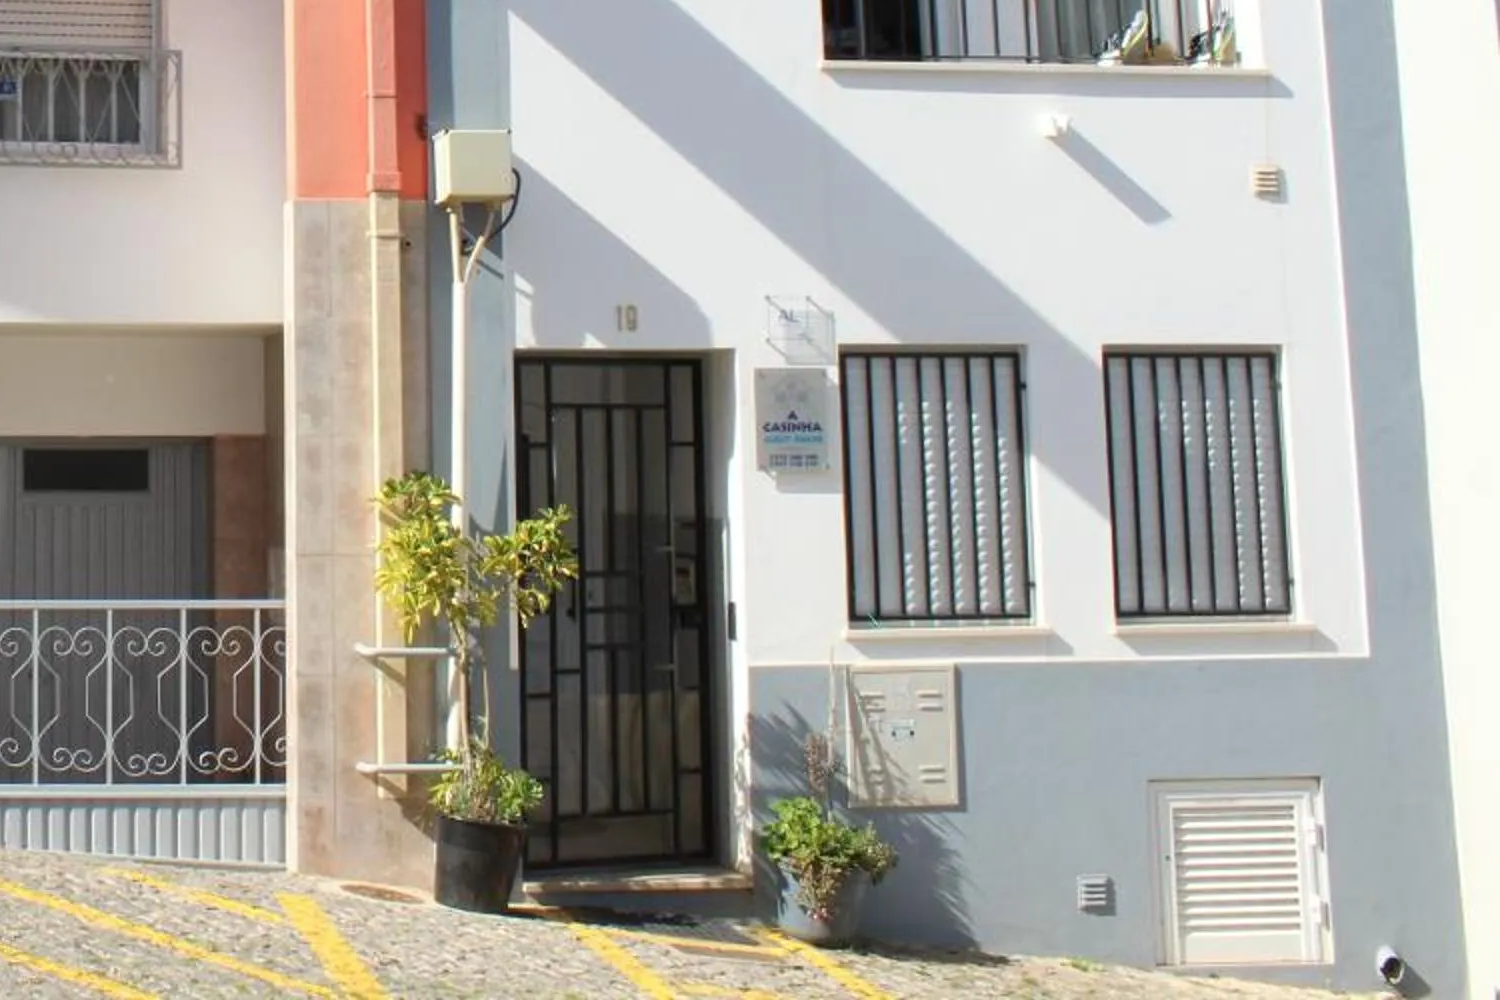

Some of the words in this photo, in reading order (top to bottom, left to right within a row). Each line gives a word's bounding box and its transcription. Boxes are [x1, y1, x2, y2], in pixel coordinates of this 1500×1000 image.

[616, 304, 638, 332] 19
[787, 410, 798, 421] A
[762, 421, 823, 433] CASINHA
